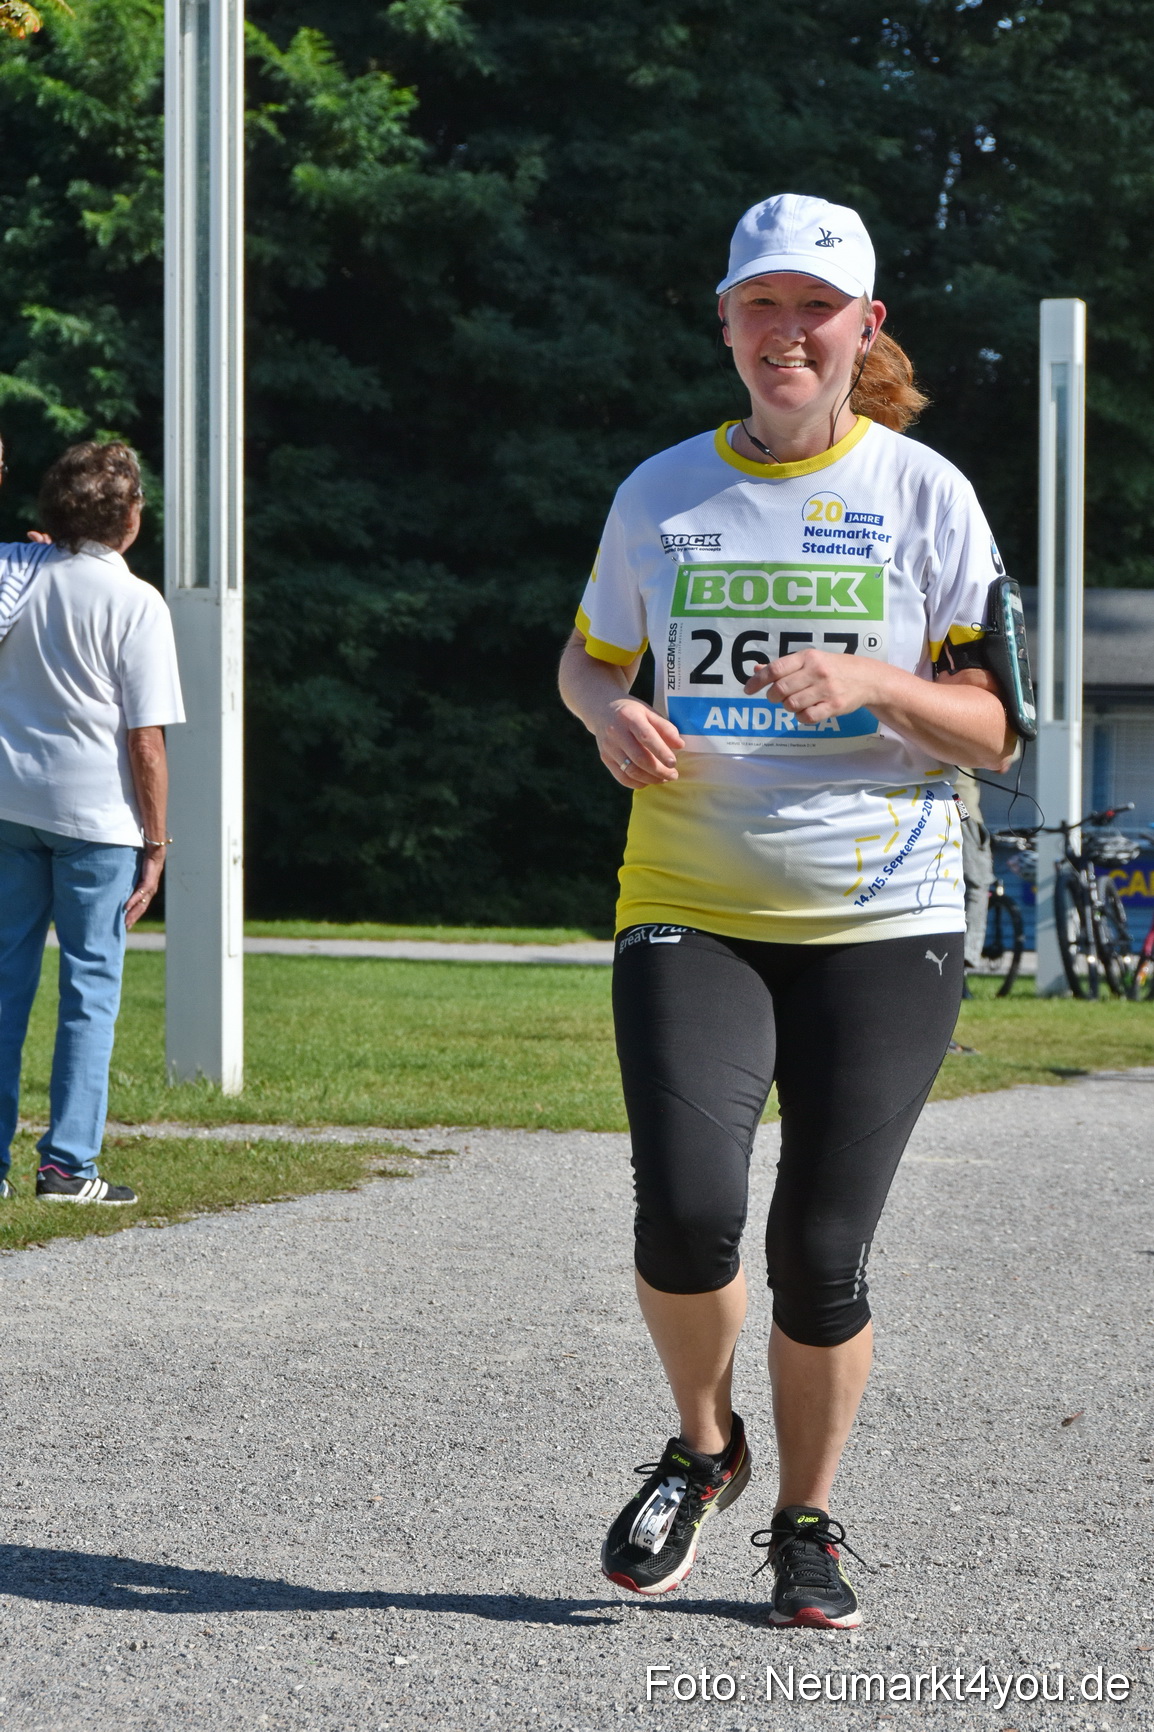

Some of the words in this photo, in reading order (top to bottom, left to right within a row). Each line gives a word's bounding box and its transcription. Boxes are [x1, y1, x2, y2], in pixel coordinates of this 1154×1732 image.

[806, 500, 844, 522] 20
[848, 513, 881, 525] JAHRE
[661, 534, 722, 549] BOCK
[804, 526, 892, 544] Neumarkter
[802, 542, 874, 559] Stadtlauf
[684, 570, 869, 613] BOCK
[868, 637, 878, 647] D
[703, 706, 841, 732] ANDRA
[854, 876, 889, 908] 14./15.
[883, 815, 927, 876] September
[922, 790, 935, 817] 2019
